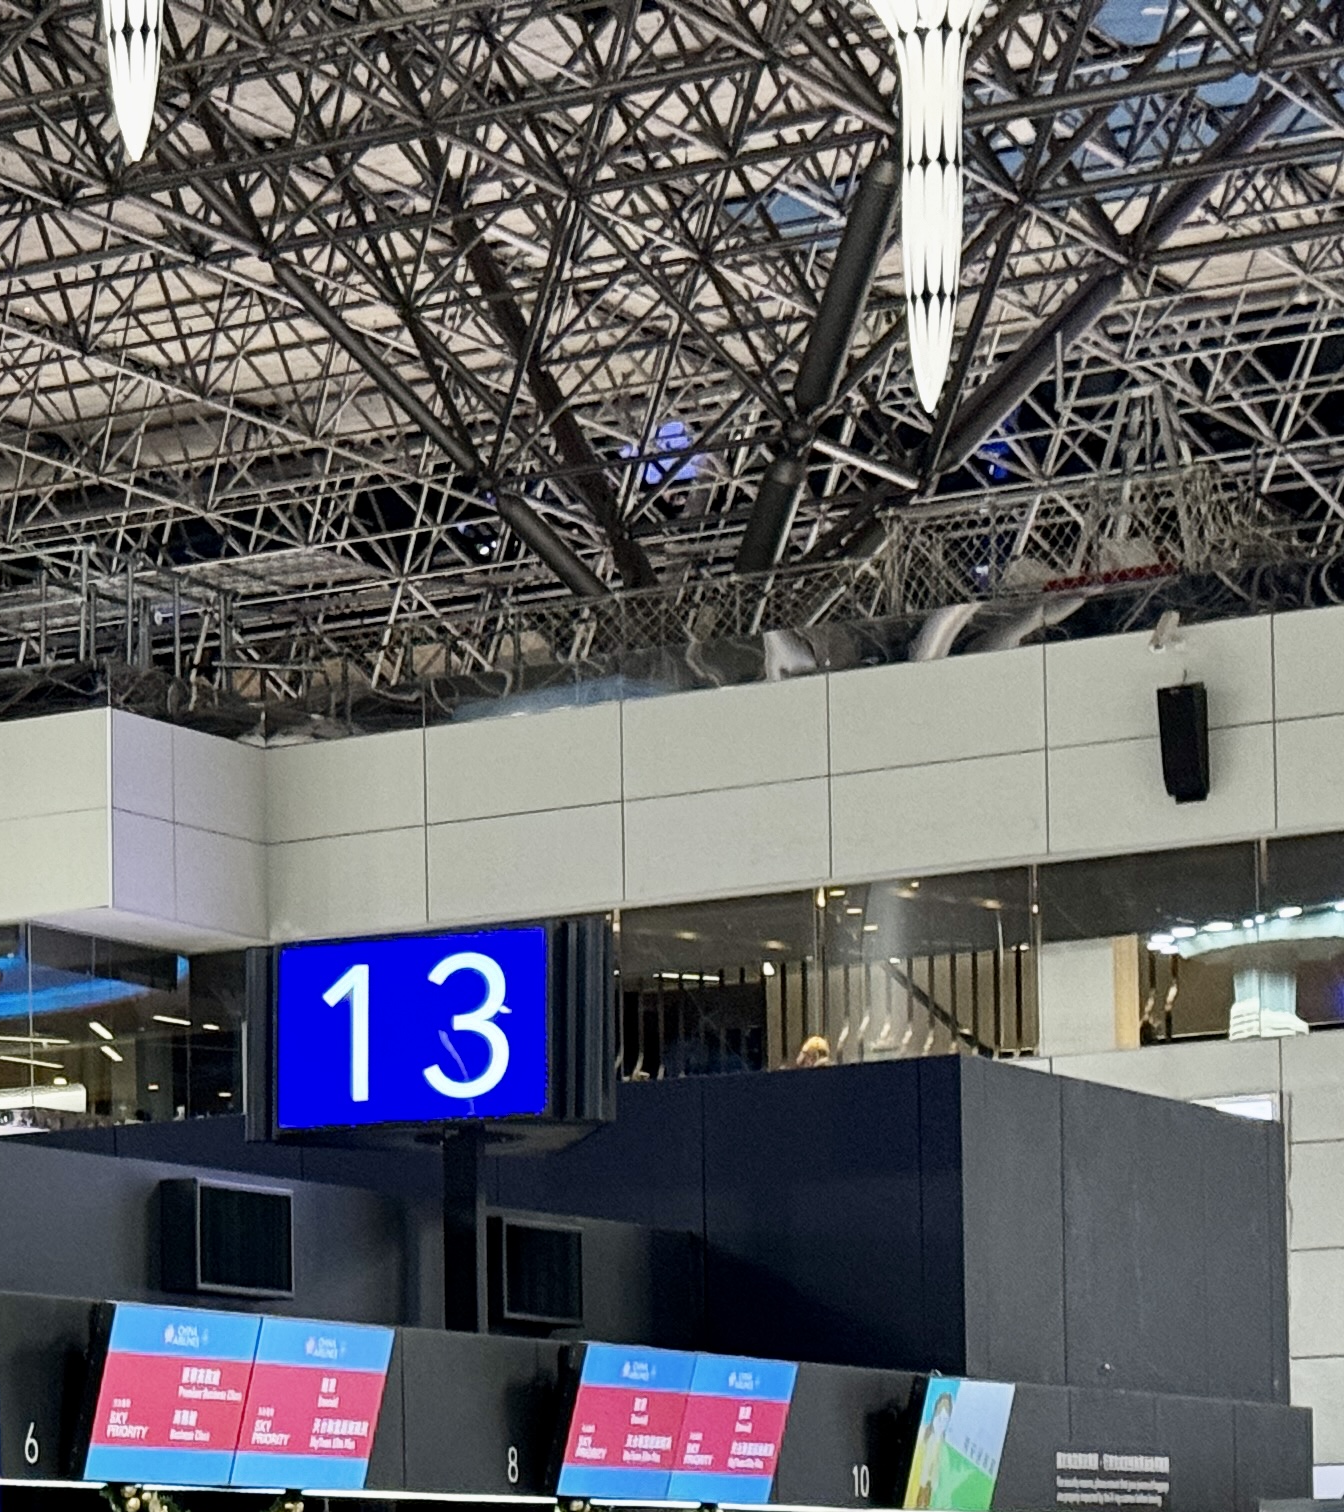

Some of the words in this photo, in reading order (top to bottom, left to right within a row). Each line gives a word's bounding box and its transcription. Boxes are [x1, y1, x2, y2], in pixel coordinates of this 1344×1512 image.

[320, 951, 512, 1104] 13
[24, 1422, 39, 1464] 6
[507, 1446, 519, 1483] 8
[852, 1464, 870, 1498] 10
